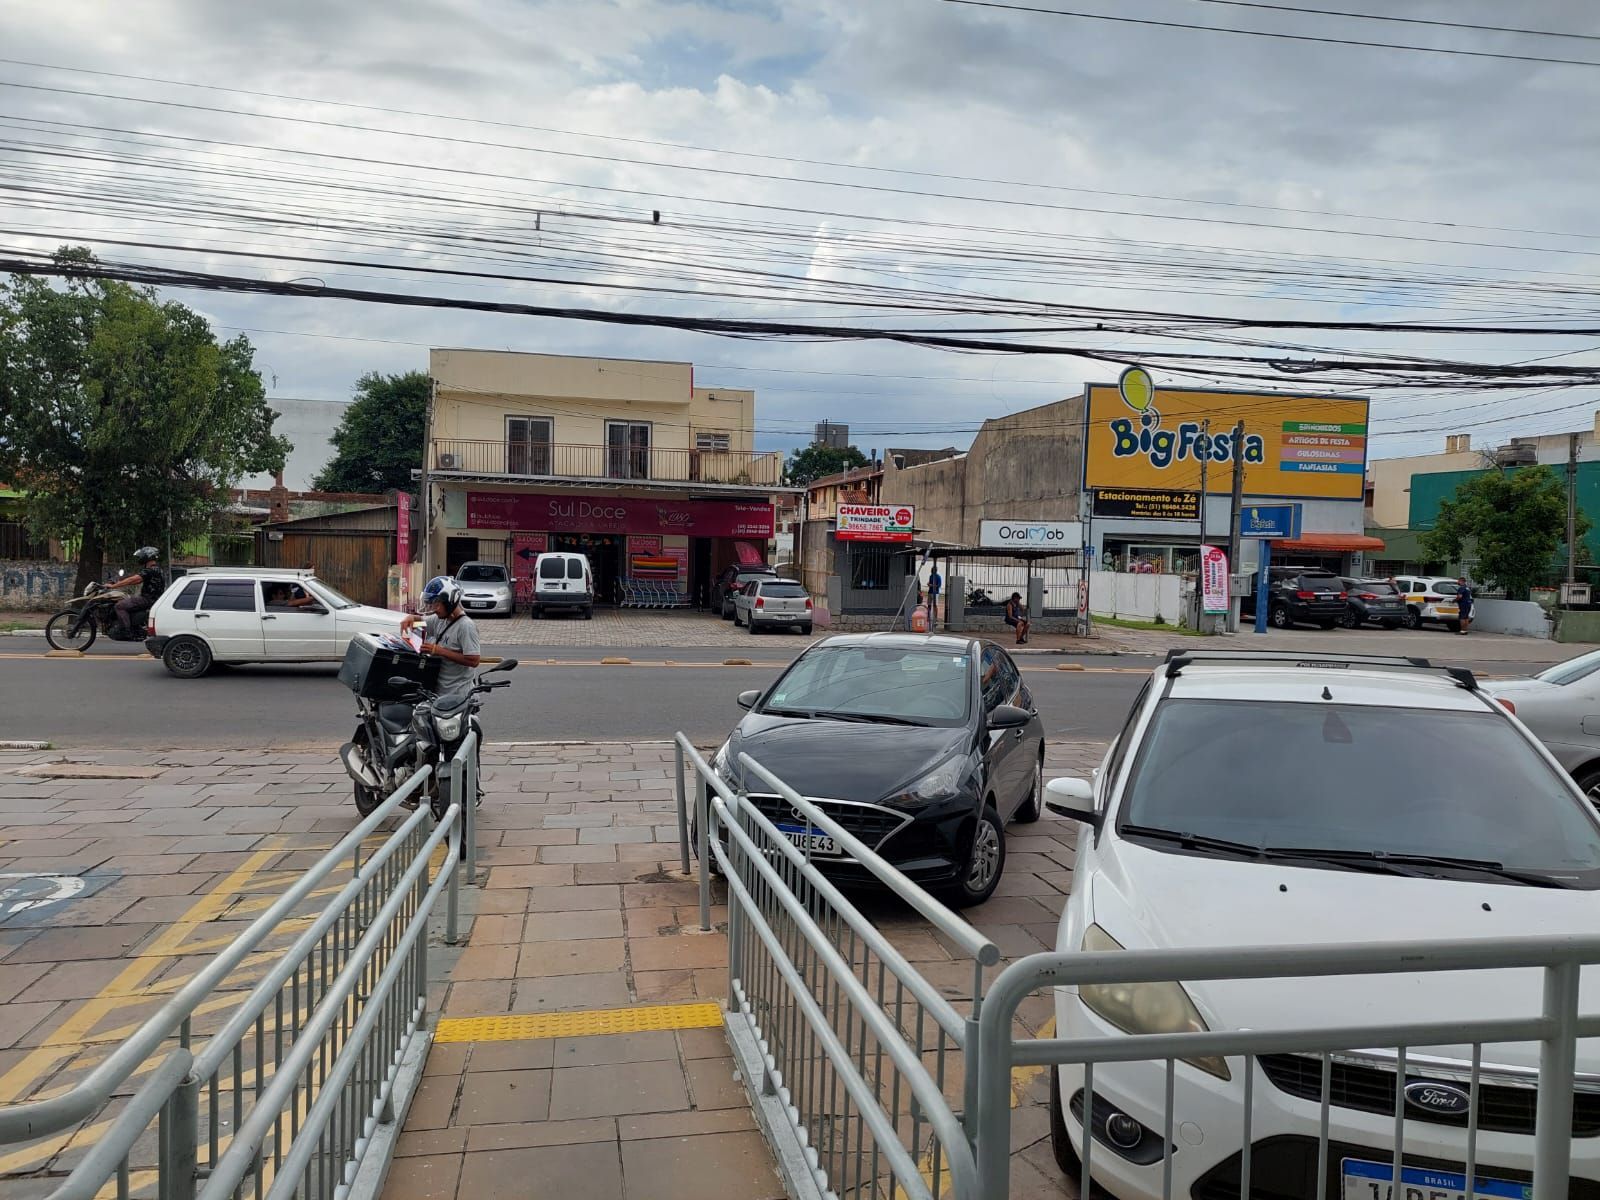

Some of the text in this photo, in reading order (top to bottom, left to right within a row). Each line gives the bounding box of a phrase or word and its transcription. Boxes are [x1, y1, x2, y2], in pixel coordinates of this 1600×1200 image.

[1288, 436, 1318, 445] ARTIGOS
[1330, 438, 1351, 446] FESTA
[1298, 463, 1338, 472] FANTASIAS
[1099, 490, 1171, 503] Estacionamento
[1183, 493, 1197, 503] Zé
[549, 500, 626, 519] Sul Doce
[839, 506, 891, 516] CHAVEIRO
[1419, 1088, 1459, 1108] Ford
[1424, 1176, 1457, 1188] BRASIL
